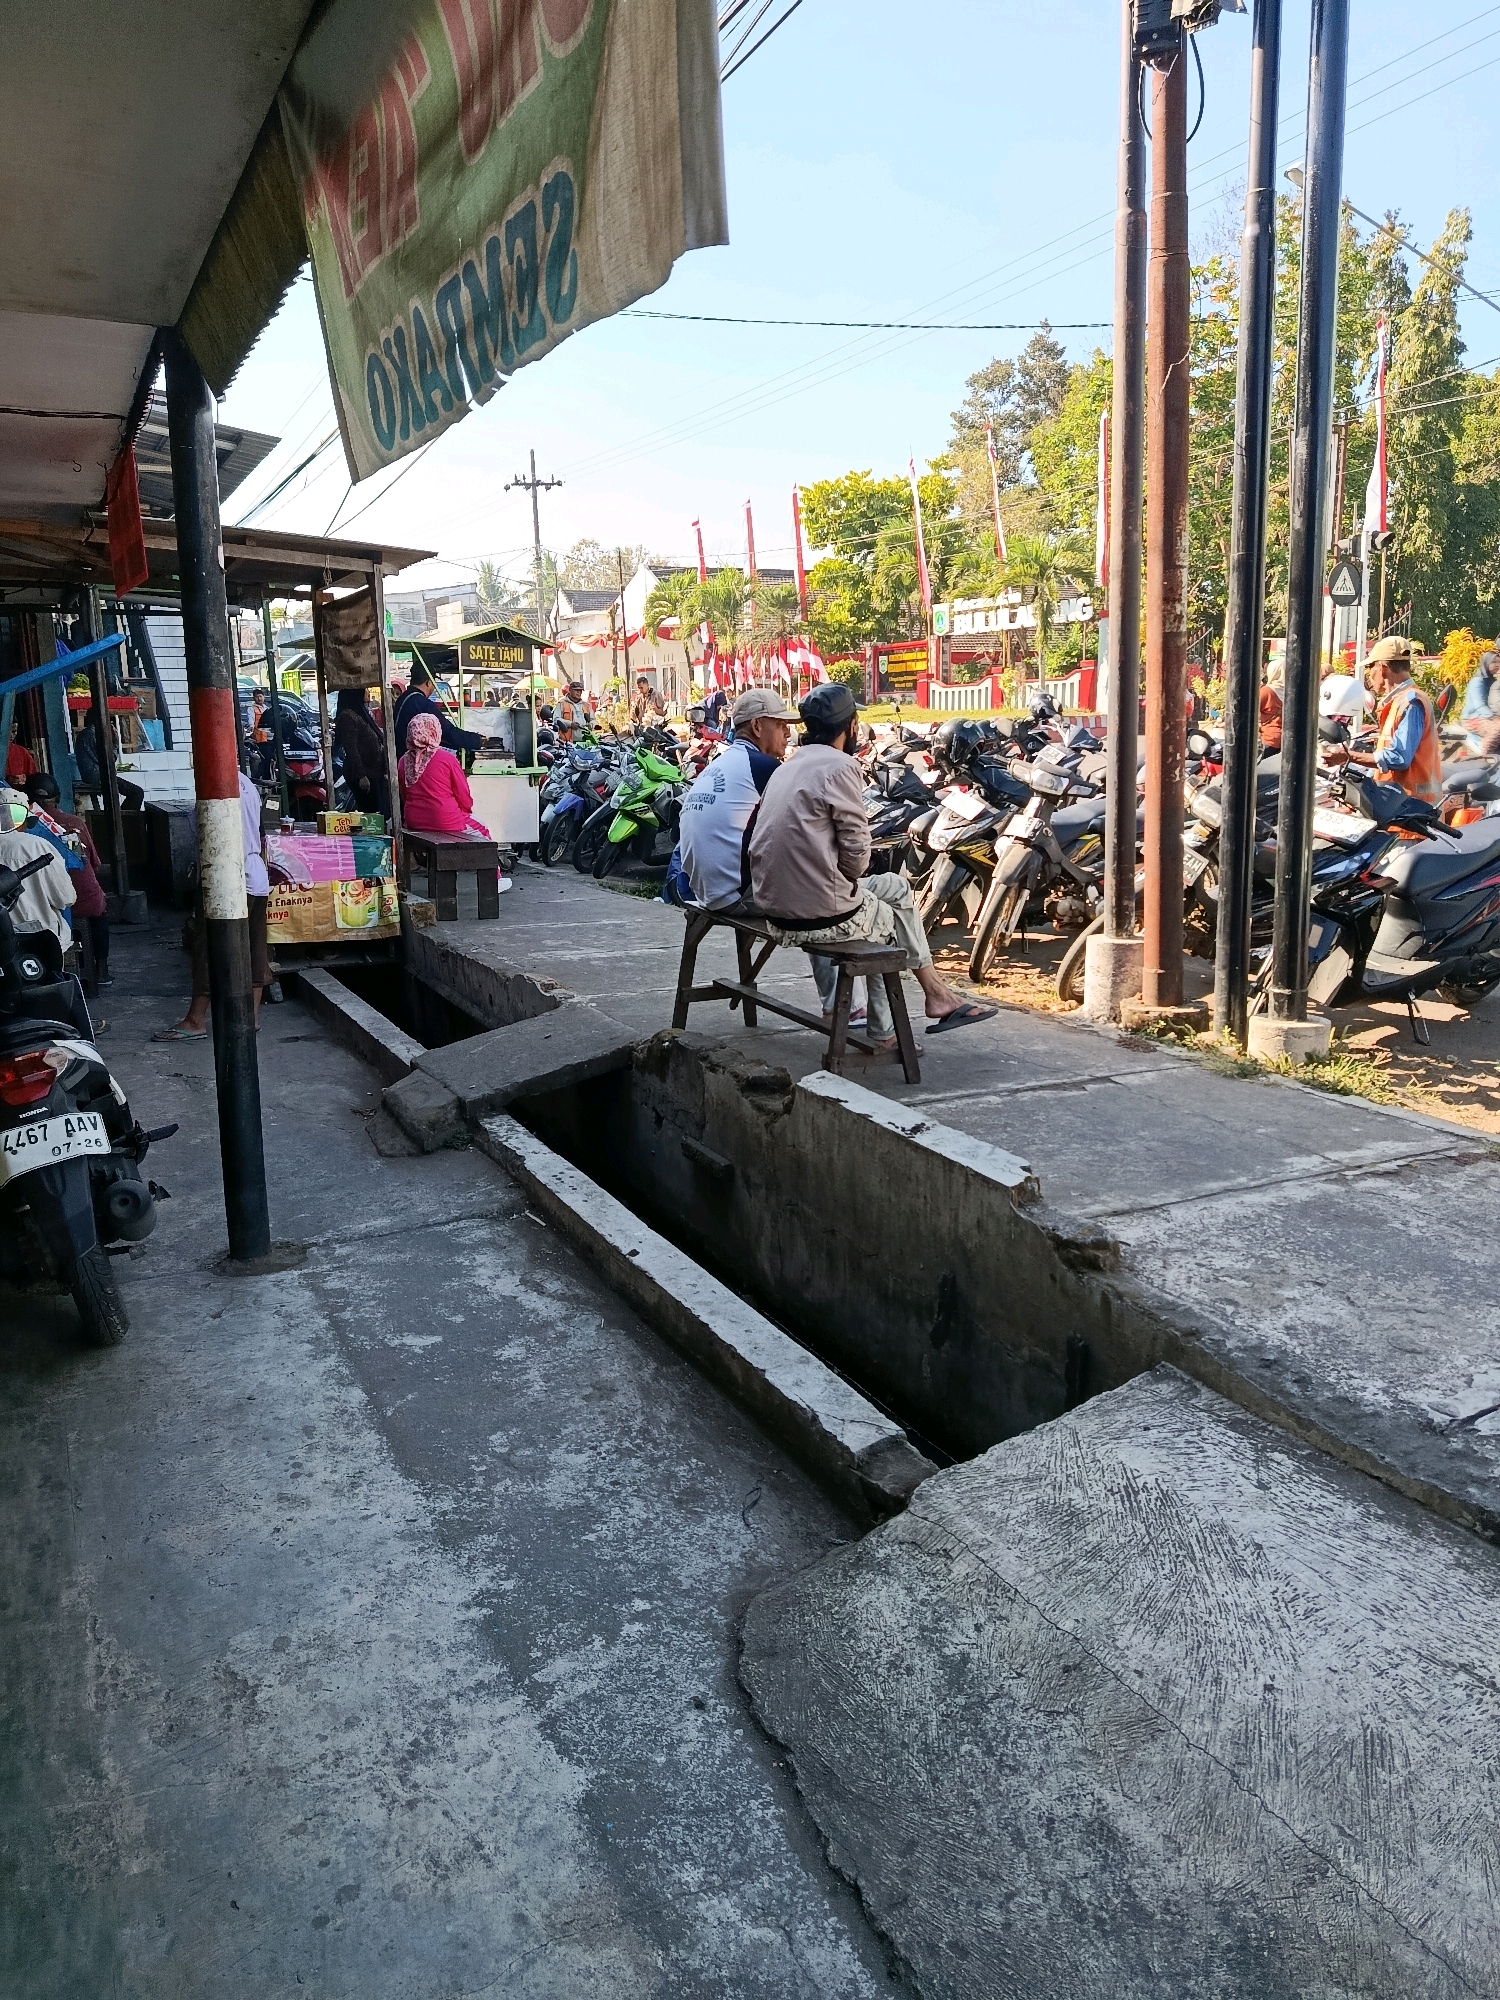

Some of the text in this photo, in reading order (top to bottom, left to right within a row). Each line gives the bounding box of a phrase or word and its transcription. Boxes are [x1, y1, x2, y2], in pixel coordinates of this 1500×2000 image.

[469, 645, 524, 662] SATE TAHU
[275, 896, 313, 907] Enaknya
[64, 1115, 99, 1134] AAV
